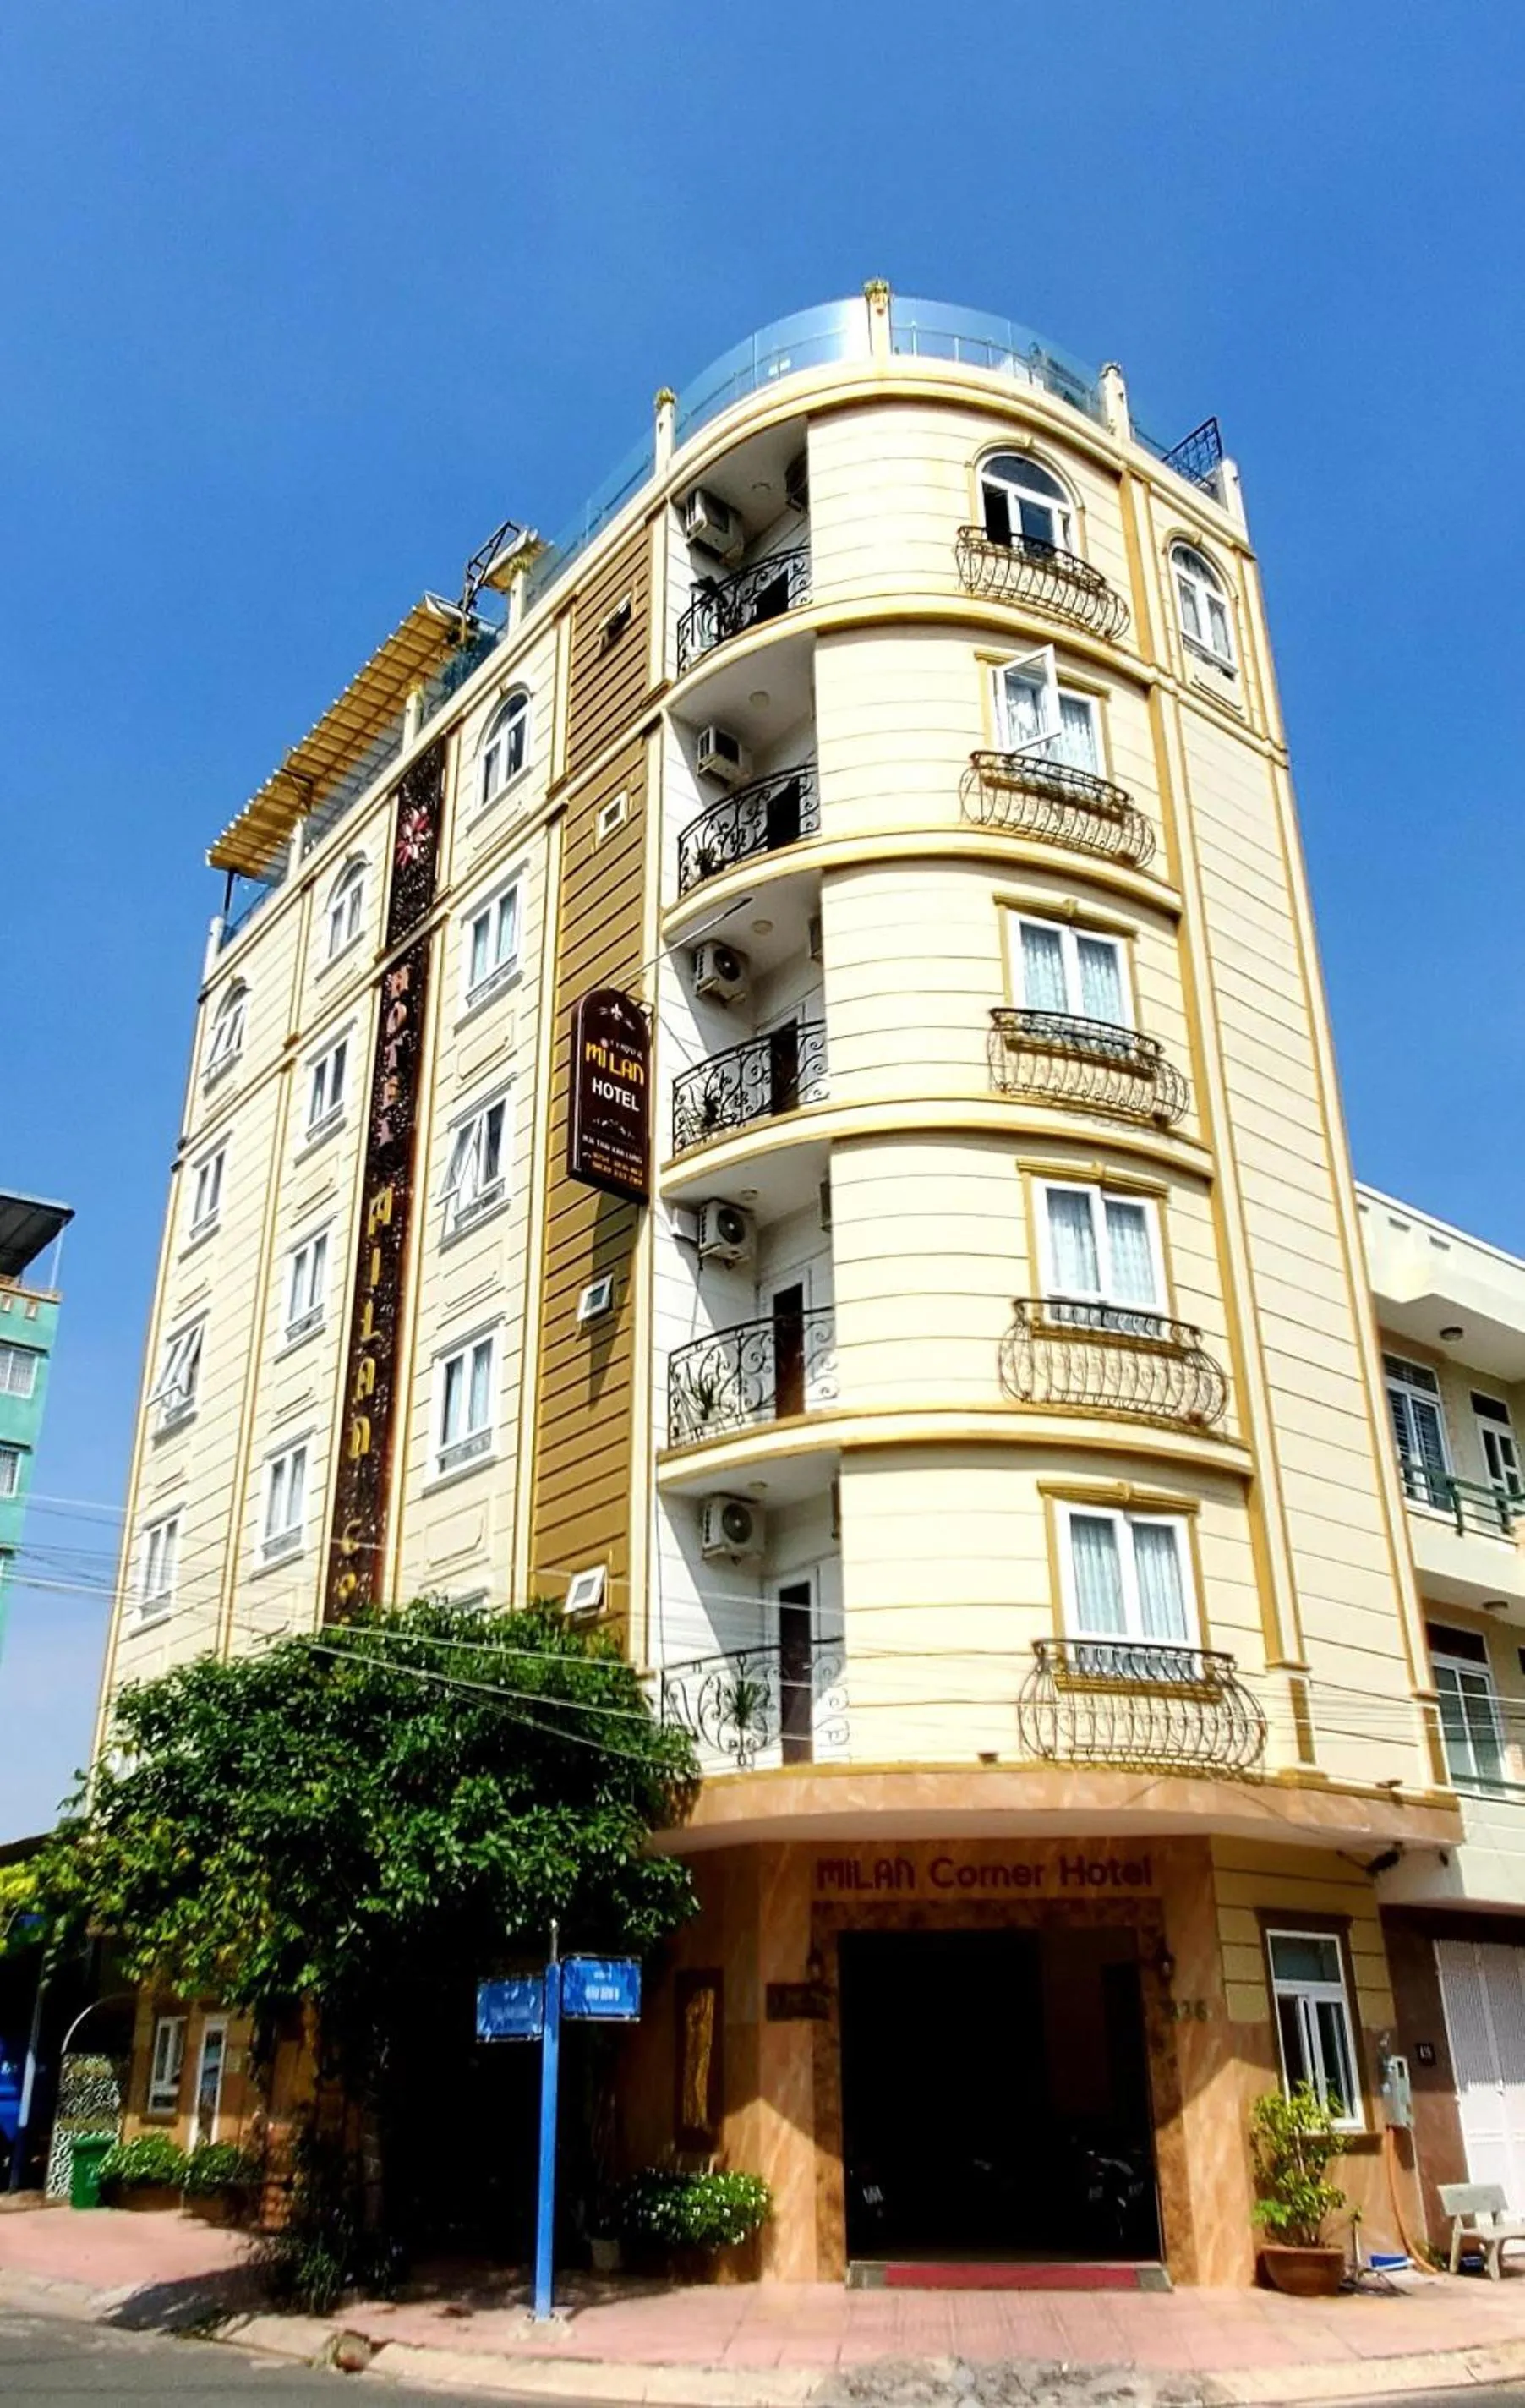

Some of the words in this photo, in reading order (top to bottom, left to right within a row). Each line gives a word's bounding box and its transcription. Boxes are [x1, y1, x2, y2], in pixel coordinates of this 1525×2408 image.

[591, 1076, 640, 1113] HOTEL
[929, 1856, 1046, 1889] Corner
[1059, 1854, 1153, 1888] Hotel
